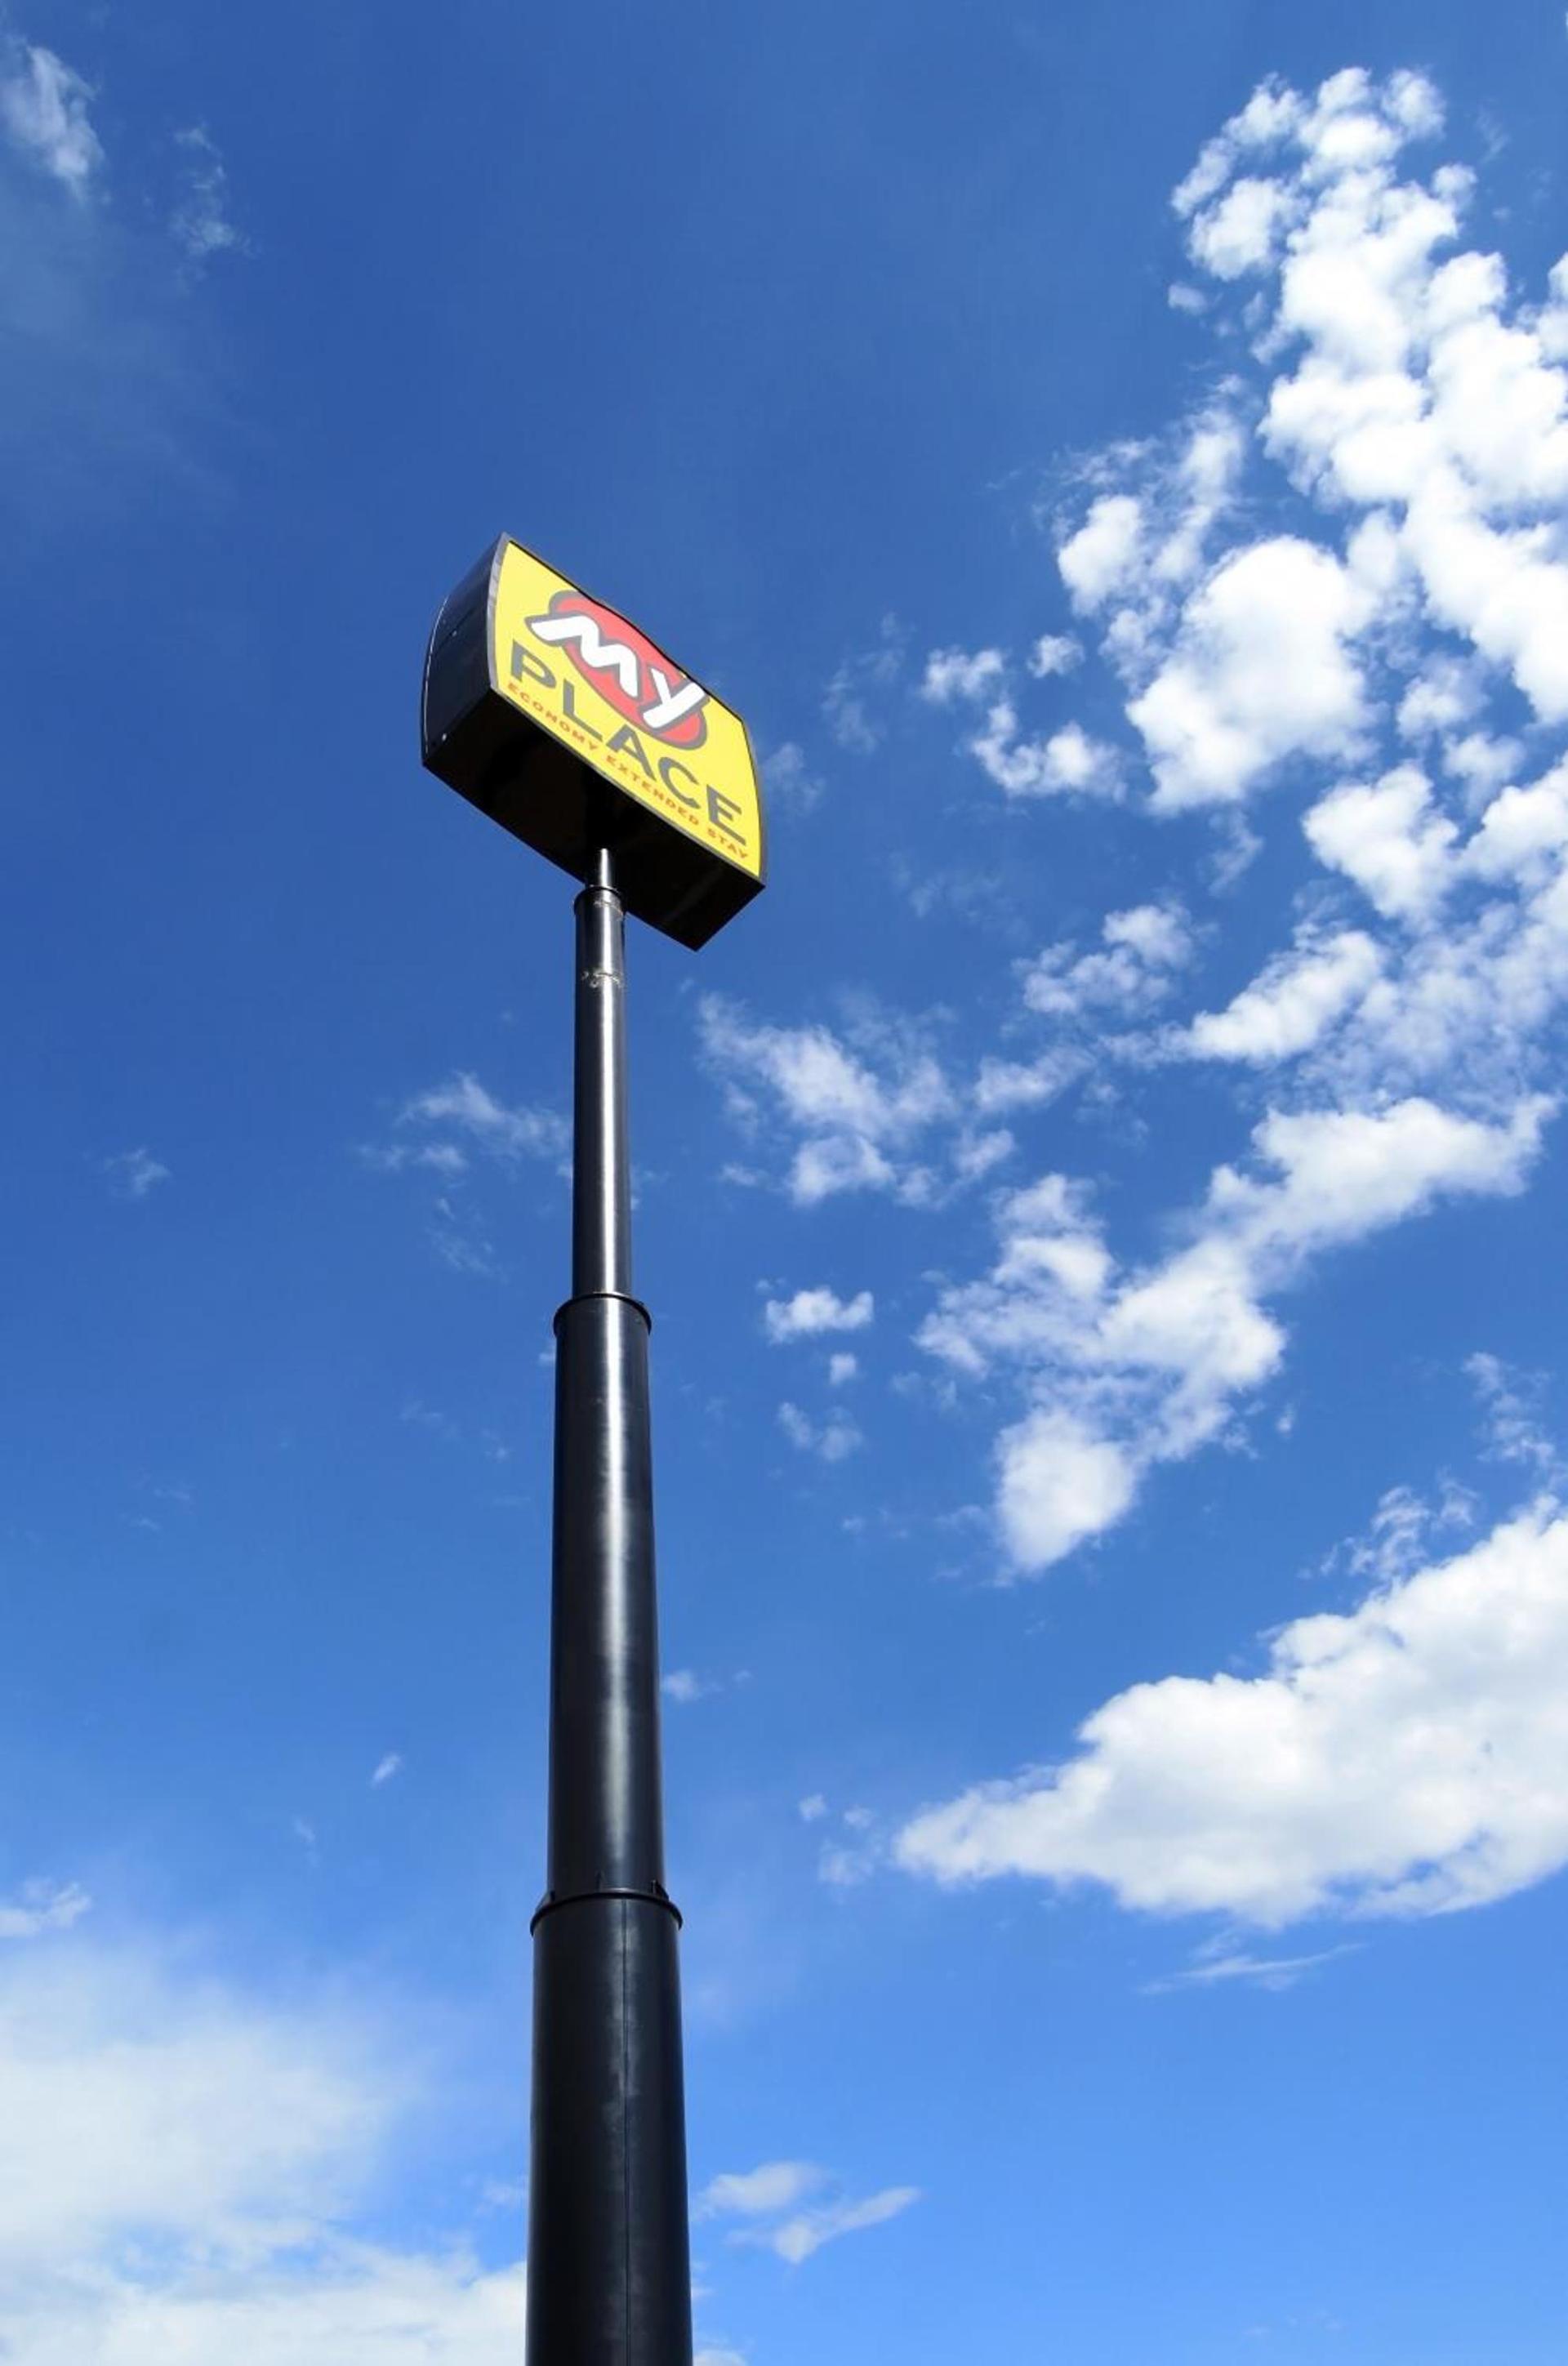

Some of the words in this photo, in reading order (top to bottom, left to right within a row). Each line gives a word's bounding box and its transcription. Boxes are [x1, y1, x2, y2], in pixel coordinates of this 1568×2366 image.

[507, 682, 599, 751] ECONOMY
[606, 755, 700, 827] EXTENDED
[707, 827, 749, 859] STAY
[511, 639, 746, 846] PLACE
